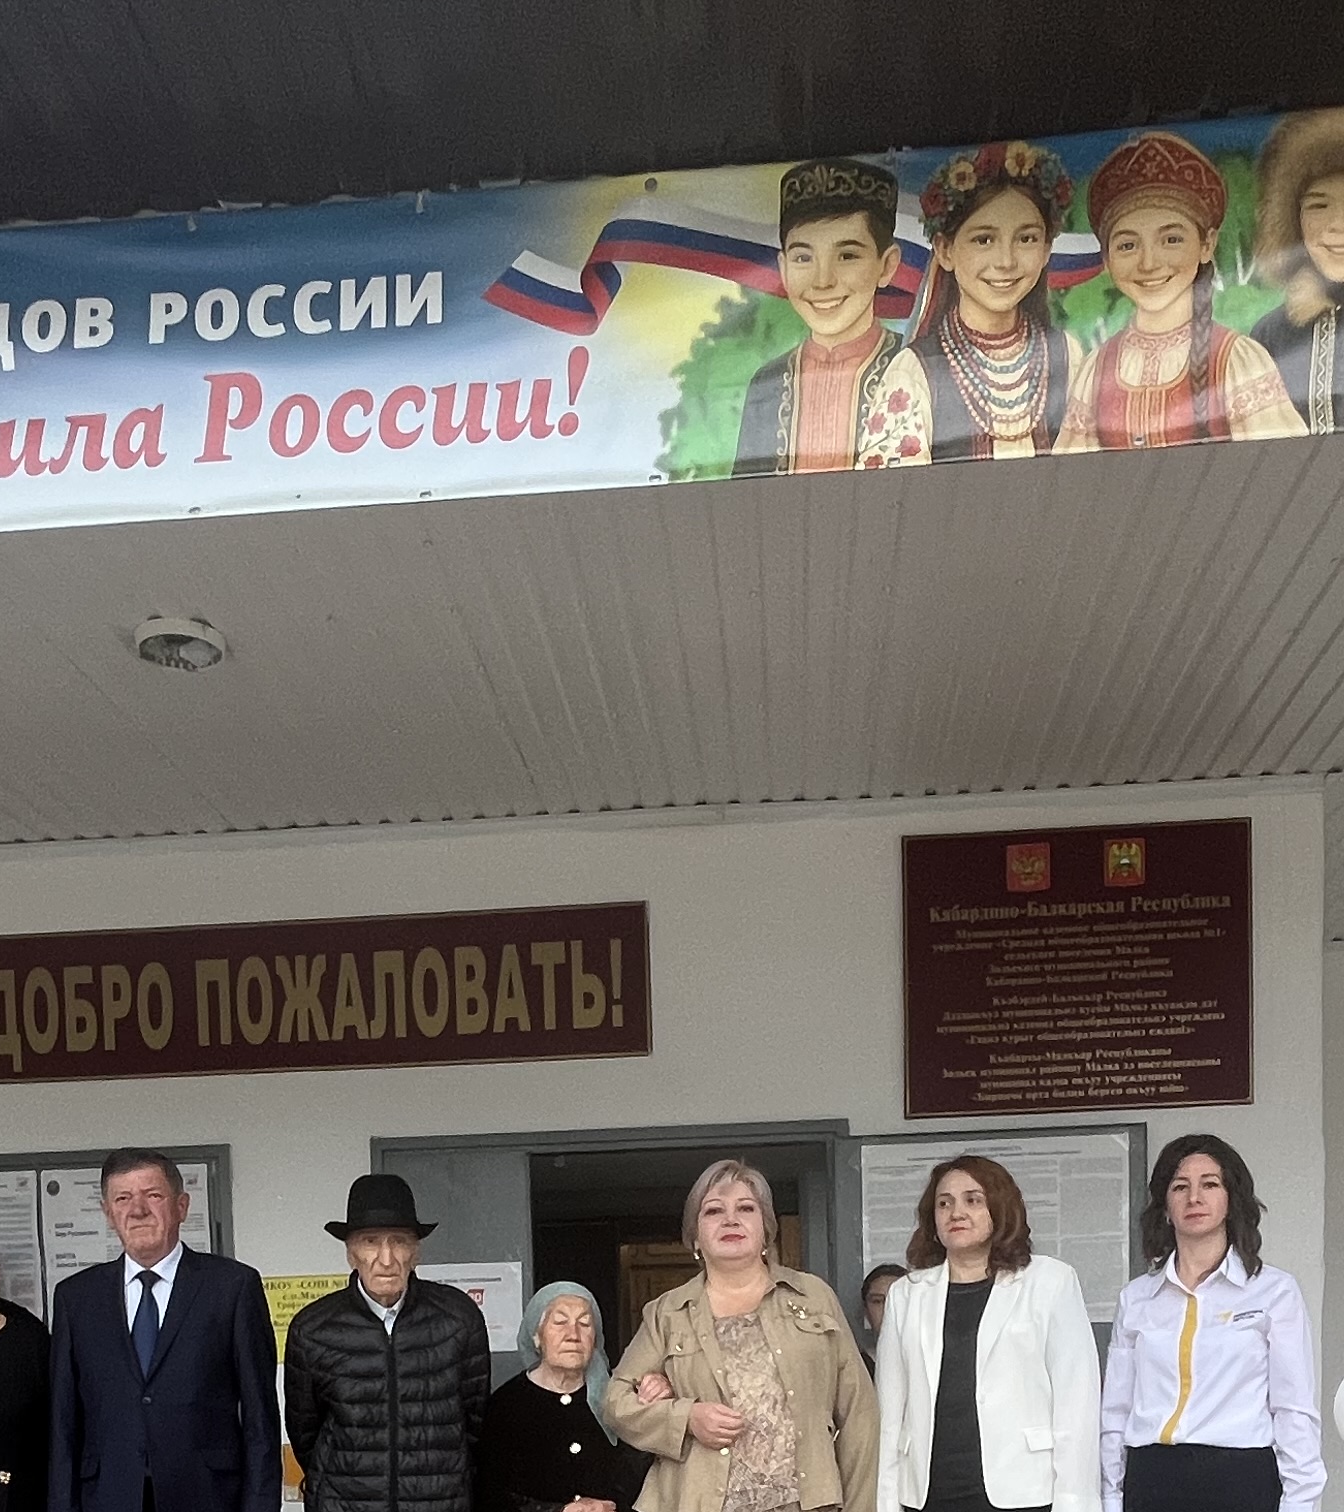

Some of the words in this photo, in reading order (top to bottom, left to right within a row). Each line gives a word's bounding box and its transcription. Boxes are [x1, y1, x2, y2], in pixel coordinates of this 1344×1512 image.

[148, 271, 443, 344] РОССИИ
[194, 346, 590, 464] России!
[929, 901, 1124, 922] Кабардино-Балкарская
[1131, 893, 1231, 913] Республика
[195, 938, 624, 1047] ПОЖАЛОВАТЬ!
